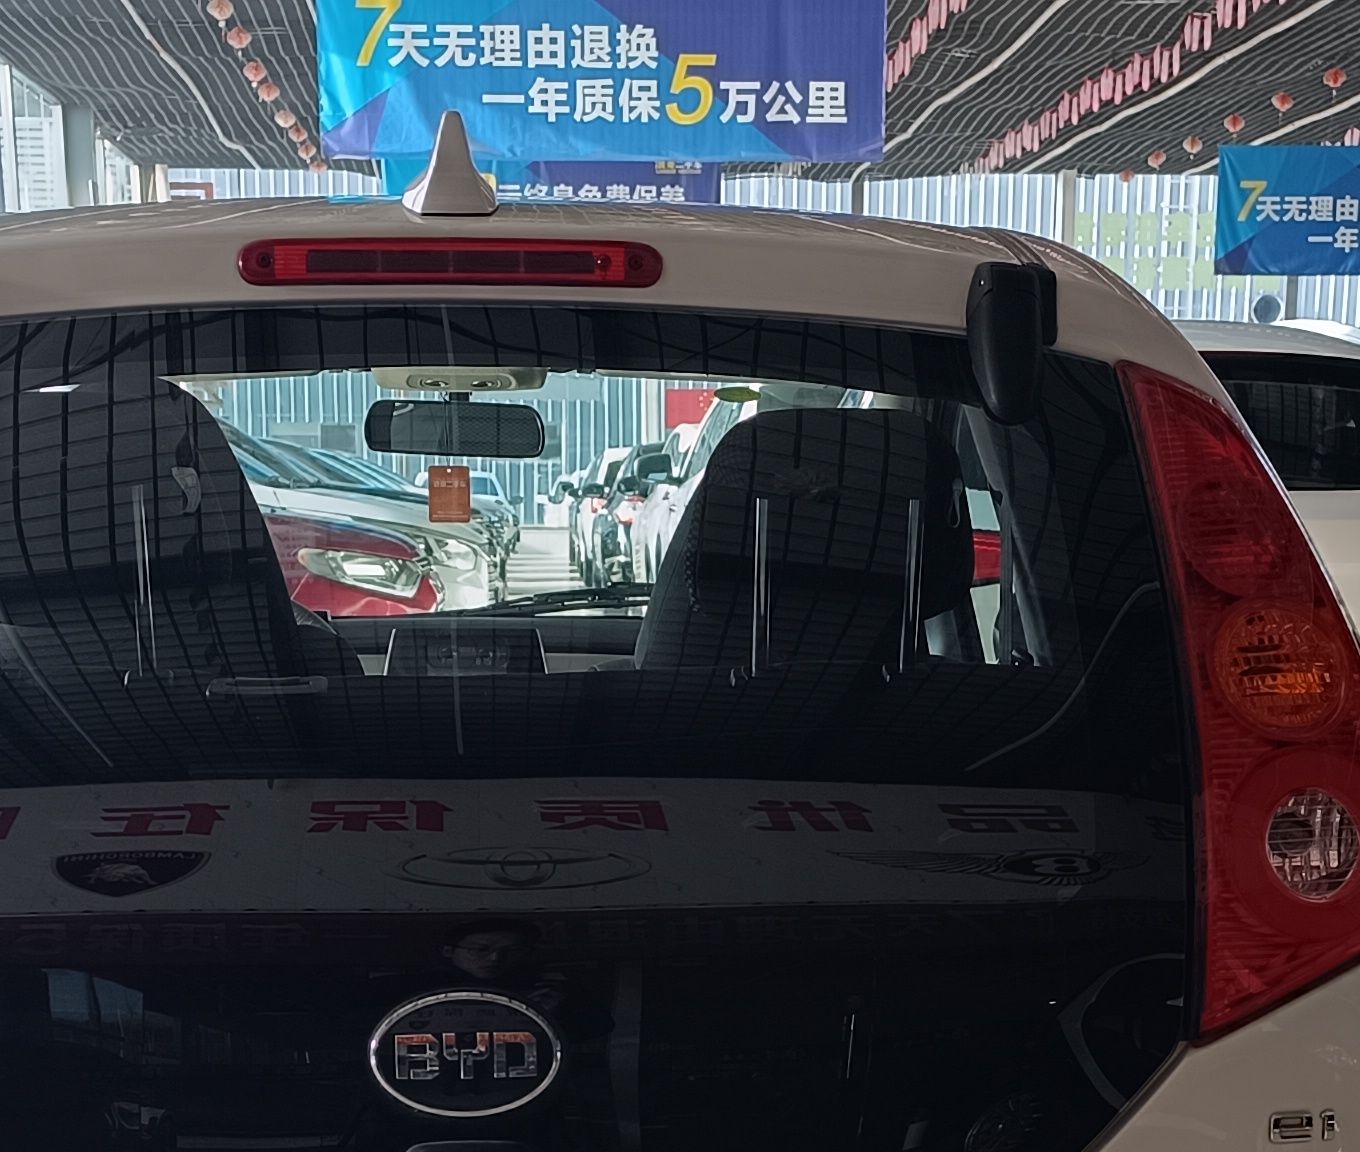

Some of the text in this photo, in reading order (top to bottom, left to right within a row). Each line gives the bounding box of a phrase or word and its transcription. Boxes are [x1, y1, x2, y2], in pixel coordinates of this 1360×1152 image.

[355, 0, 659, 70] 7天无理由退换
[482, 54, 849, 126] 一年质保5万公里
[394, 1031, 538, 1081] BYD
